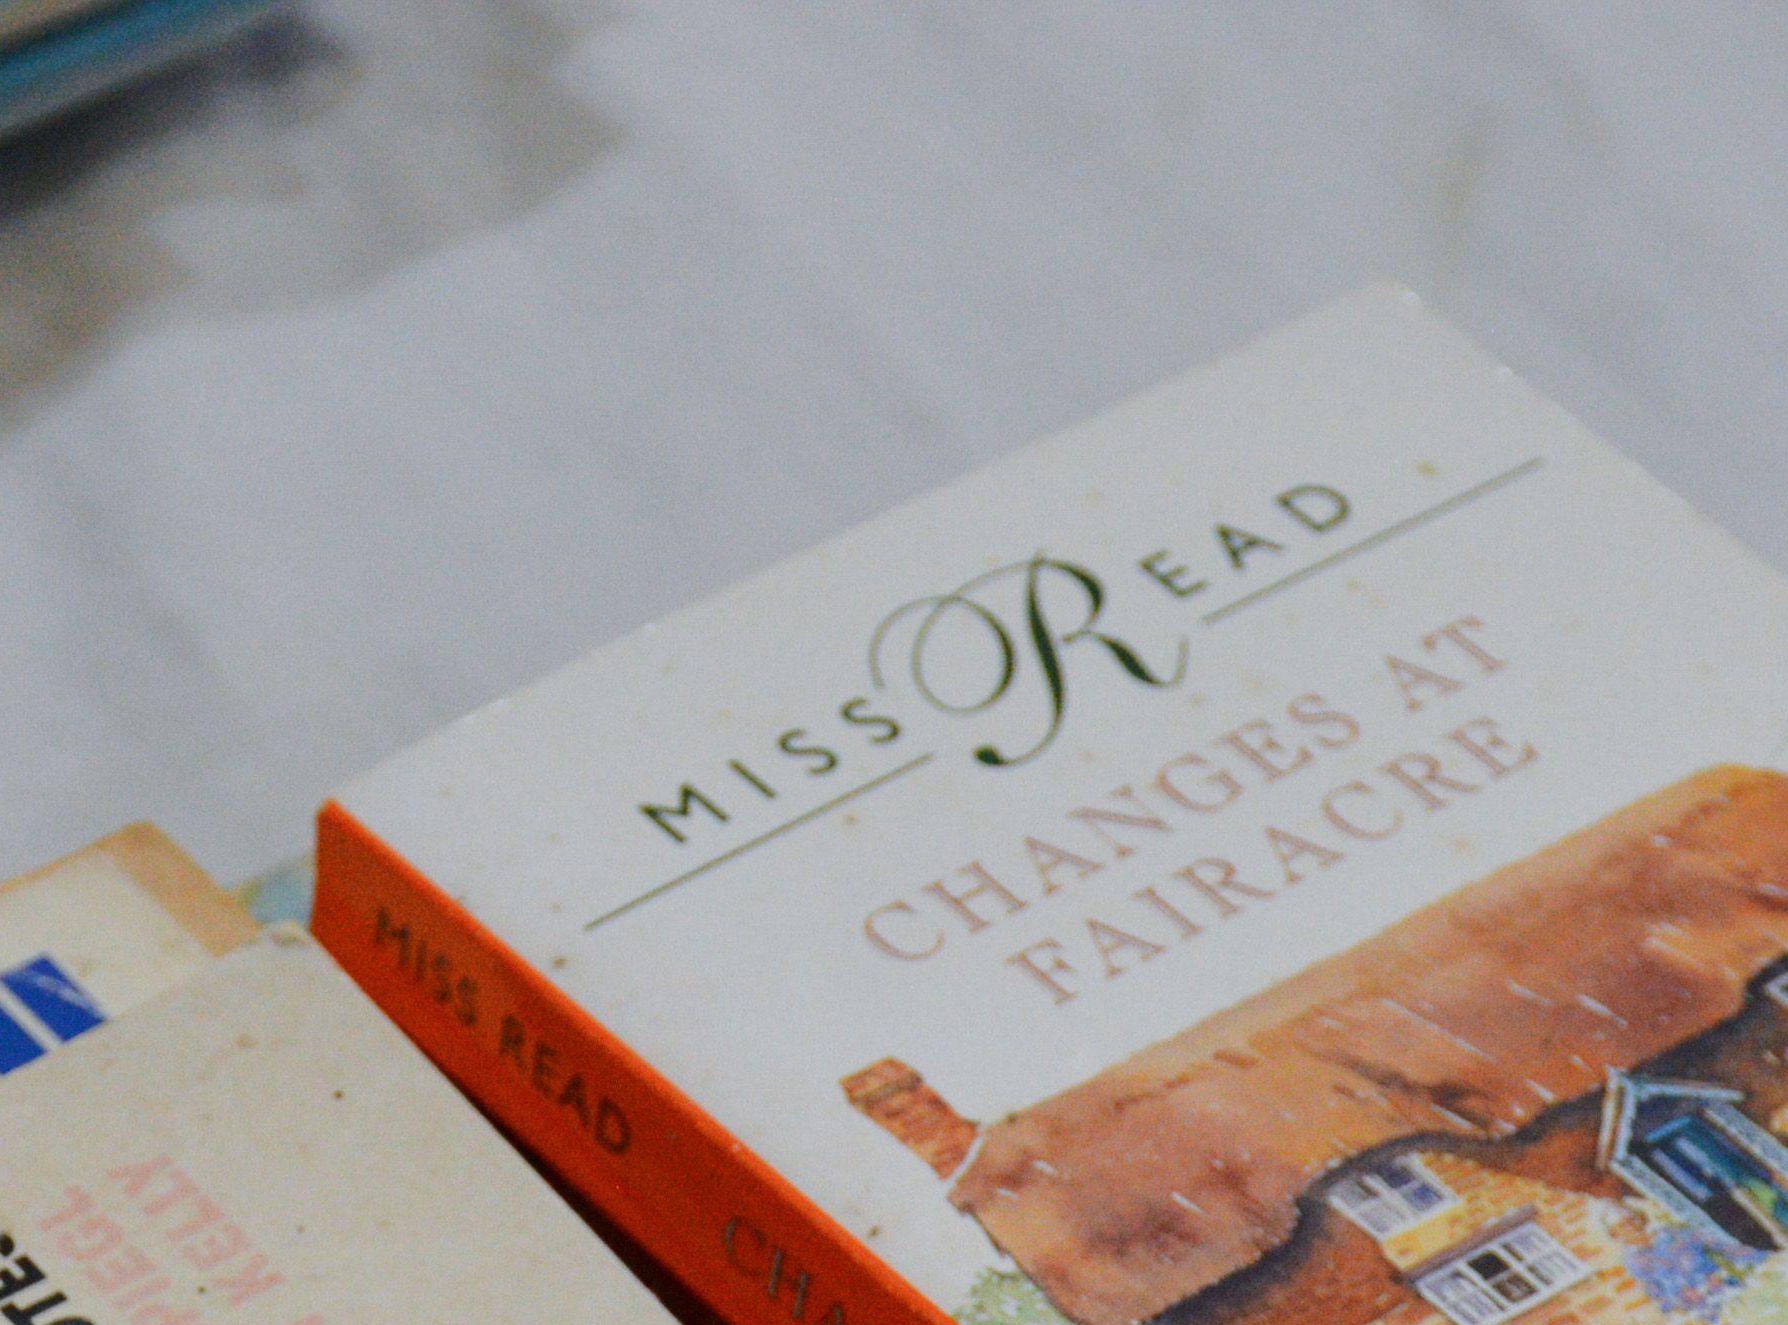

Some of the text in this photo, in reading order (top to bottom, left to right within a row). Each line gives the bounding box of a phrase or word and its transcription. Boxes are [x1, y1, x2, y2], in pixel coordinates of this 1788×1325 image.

[639, 482, 1353, 845] MISS READ
[860, 613, 1513, 965] CHANGES AT
[1006, 715, 1543, 1006] FAIRACRE
[372, 904, 479, 1030] MISS
[499, 1015, 633, 1157] READ
[107, 1153, 288, 1308] KELLY
